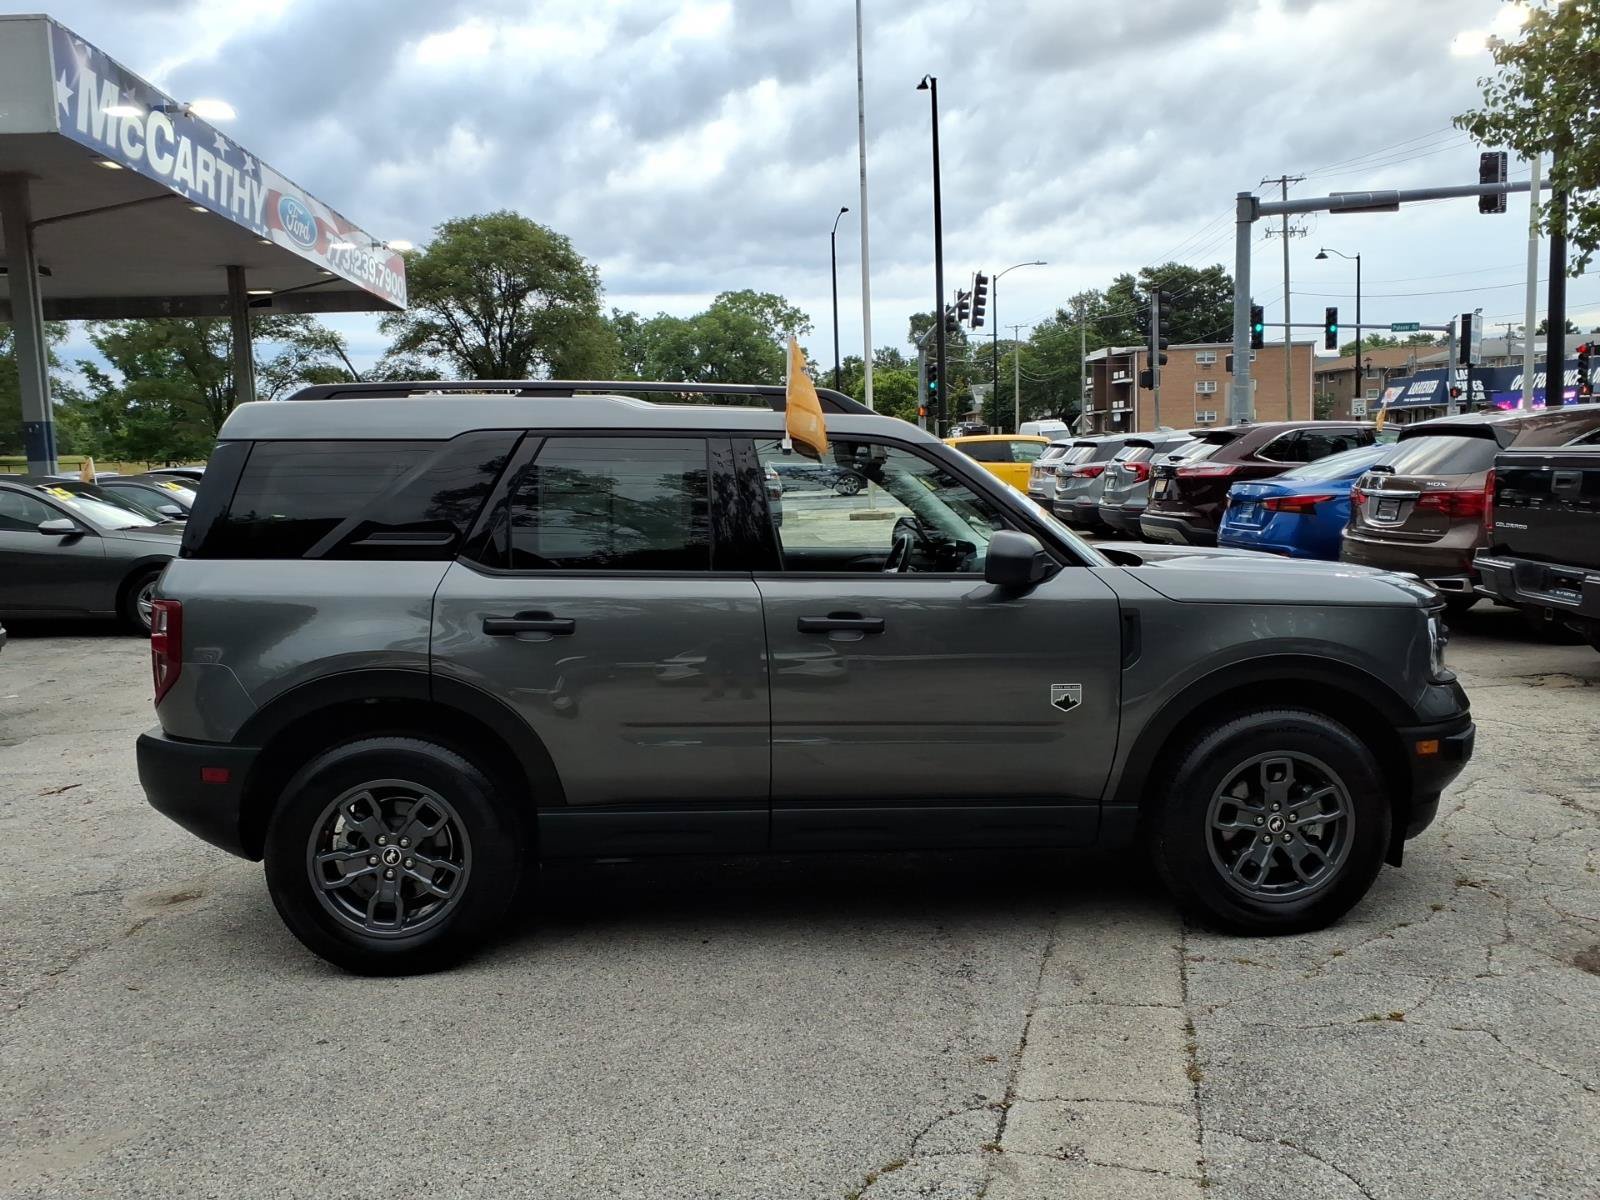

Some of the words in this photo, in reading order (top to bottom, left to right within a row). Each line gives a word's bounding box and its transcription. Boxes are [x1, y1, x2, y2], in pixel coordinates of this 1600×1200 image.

[286, 201, 311, 241] Ford
[1354, 407, 1365, 415] 35
[1495, 521, 1528, 530] COLORADO
